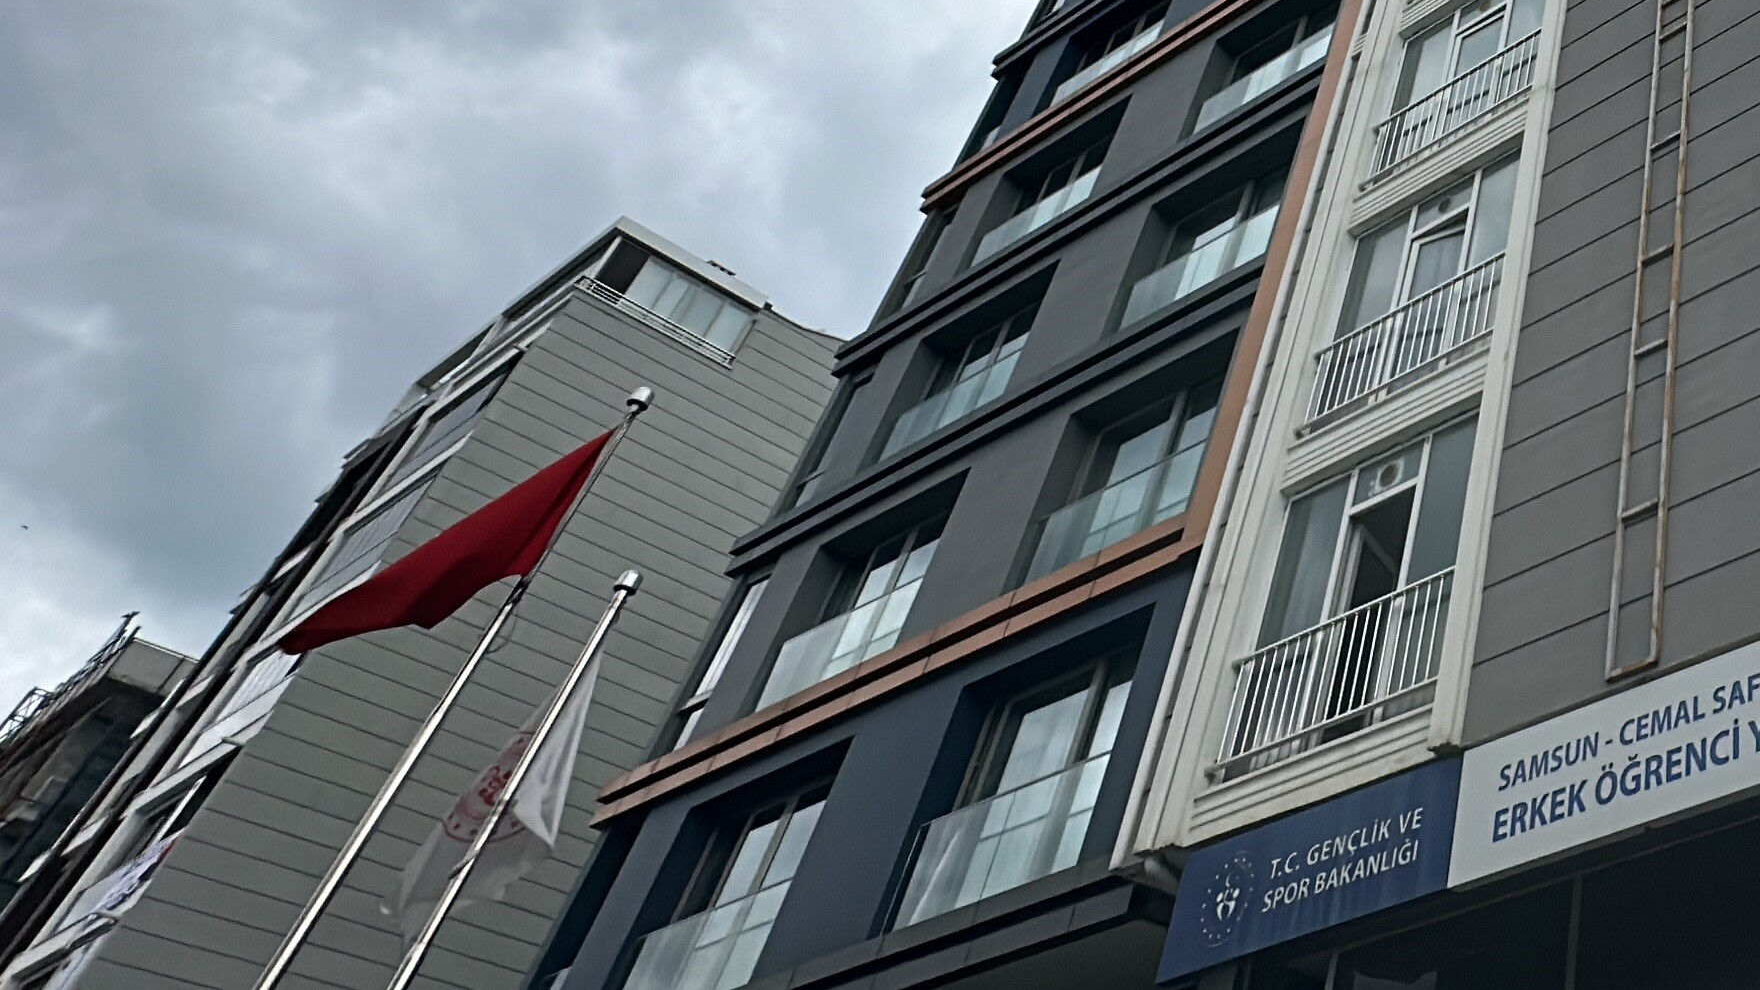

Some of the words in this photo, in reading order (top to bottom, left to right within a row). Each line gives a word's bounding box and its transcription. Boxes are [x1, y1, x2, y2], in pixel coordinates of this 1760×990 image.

[1492, 779, 1588, 843] ERKEK
[1595, 718, 1741, 806] ÖĞRENCİ
[1498, 731, 1600, 792] SAMSUN
[1619, 695, 1706, 746] CEMAL
[1261, 877, 1310, 913] SPOR
[1314, 838, 1419, 895] BAKANLIĞI
[1270, 851, 1300, 879] T.C.
[1306, 818, 1392, 866] GENÇLİK
[1399, 807, 1423, 834] VE
